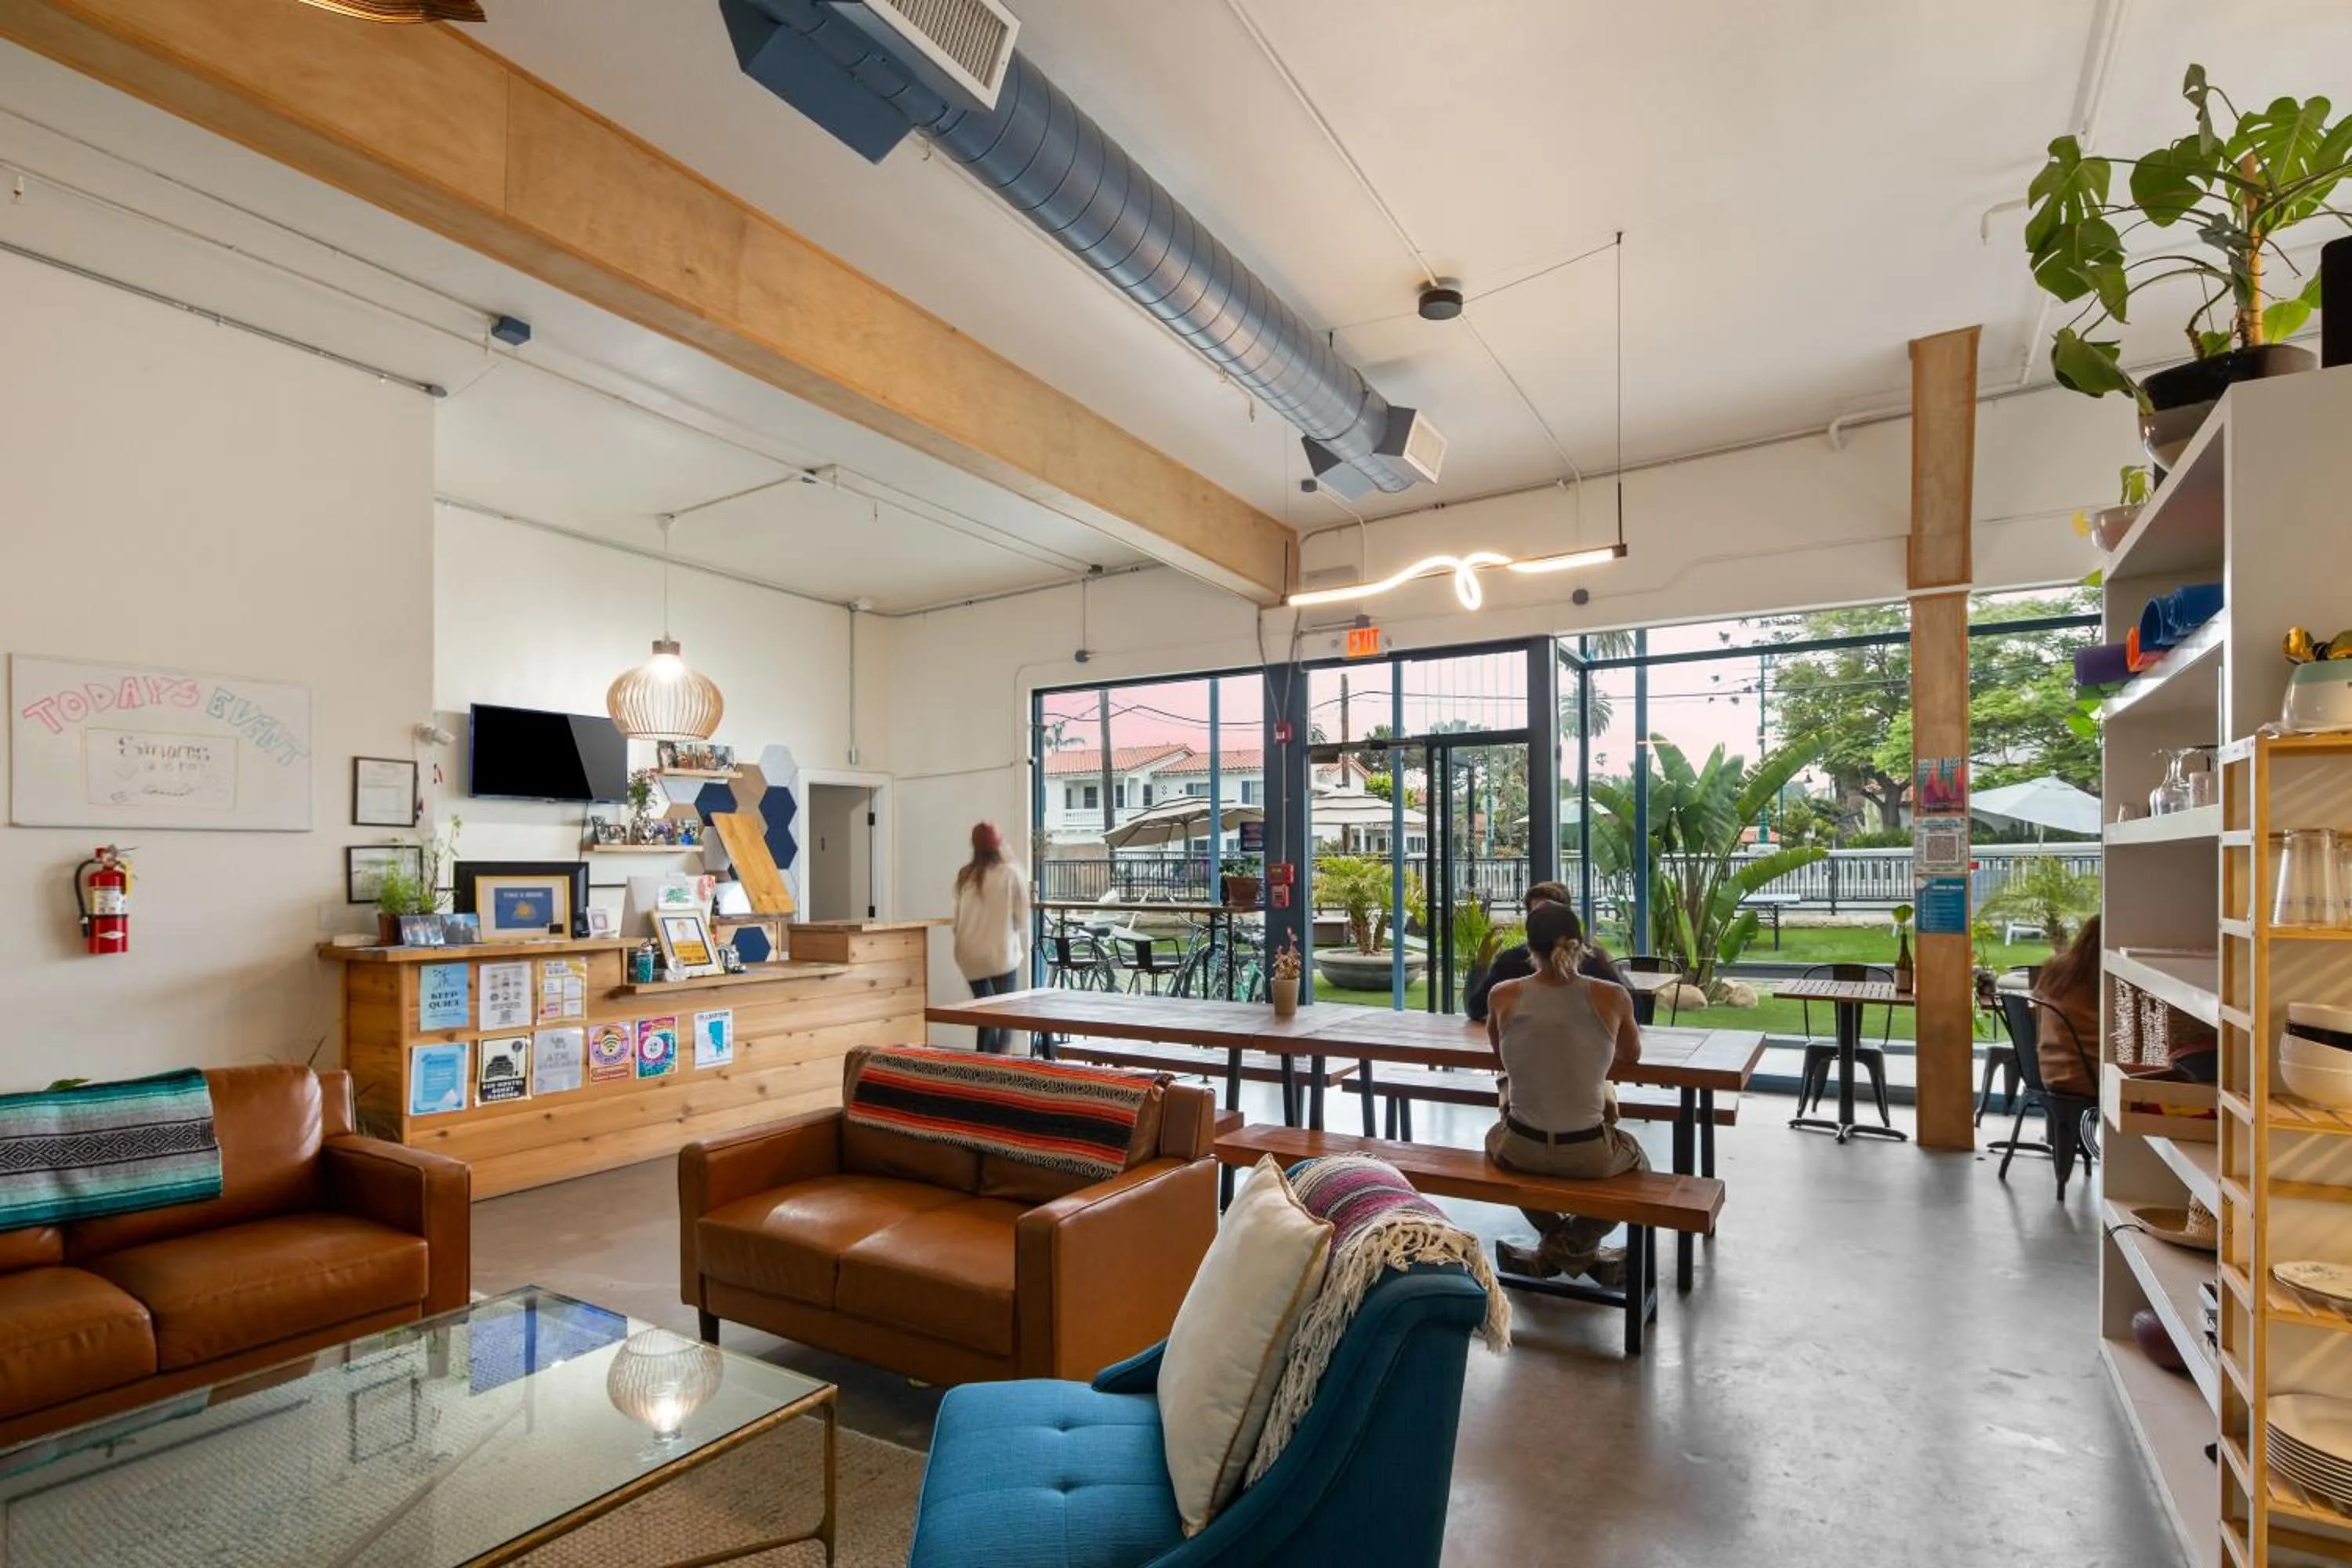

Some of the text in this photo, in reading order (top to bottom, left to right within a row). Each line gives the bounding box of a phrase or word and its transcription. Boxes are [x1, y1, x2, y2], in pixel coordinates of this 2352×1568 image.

[1348, 628, 1379, 653] EXIT
[23, 676, 307, 767] TODAYS EVENT
[428, 1000, 459, 1010] QUIET
